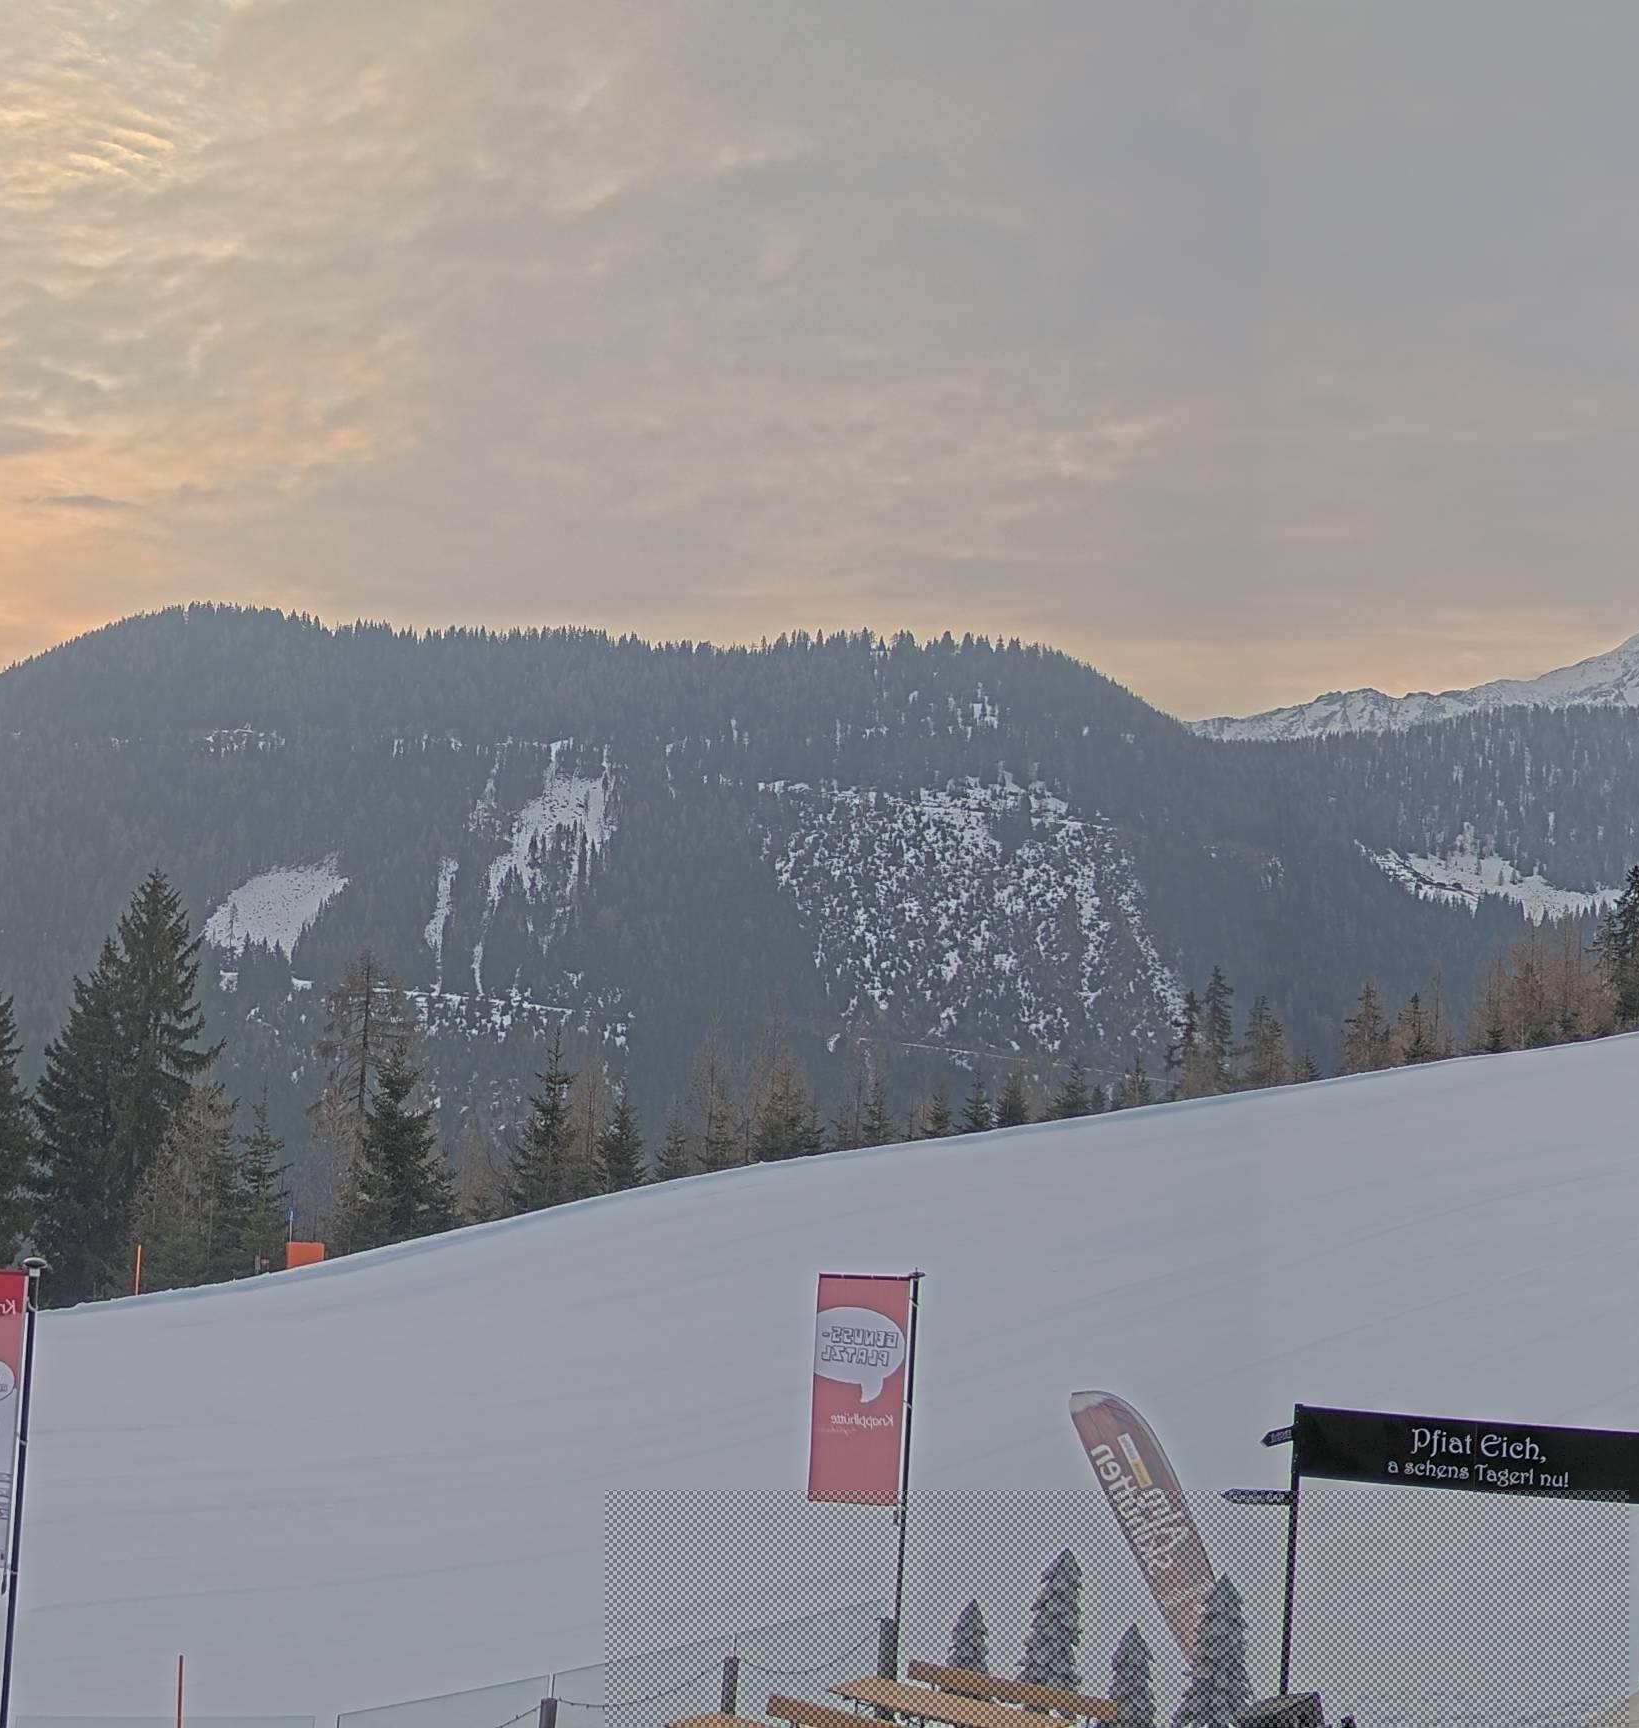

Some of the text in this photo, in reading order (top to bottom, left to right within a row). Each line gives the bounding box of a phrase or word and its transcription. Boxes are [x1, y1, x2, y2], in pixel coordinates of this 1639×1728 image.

[1410, 1427, 1547, 1464] Pfiat Eich,
[1388, 1460, 1570, 1488] a schens Tagerl nu!
